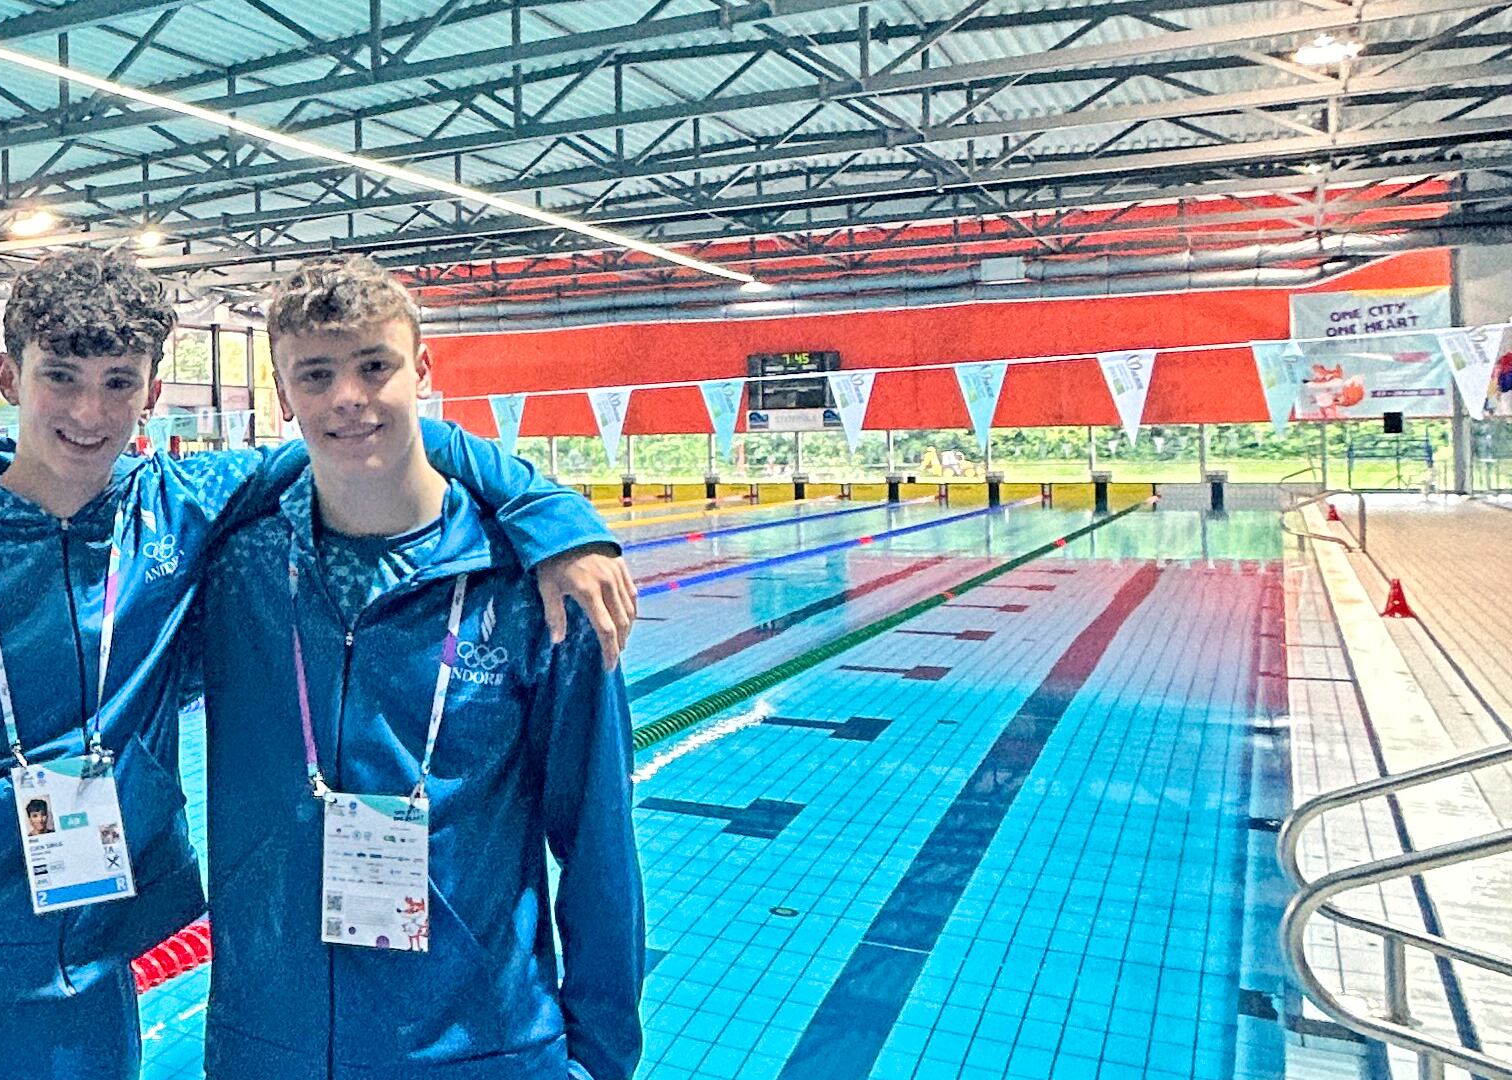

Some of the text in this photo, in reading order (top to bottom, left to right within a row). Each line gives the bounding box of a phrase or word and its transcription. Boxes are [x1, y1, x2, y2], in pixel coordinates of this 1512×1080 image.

[1330, 308, 1361, 322] ONE
[1326, 315, 1419, 337] ONE HEART
[37, 892, 48, 906] 2
